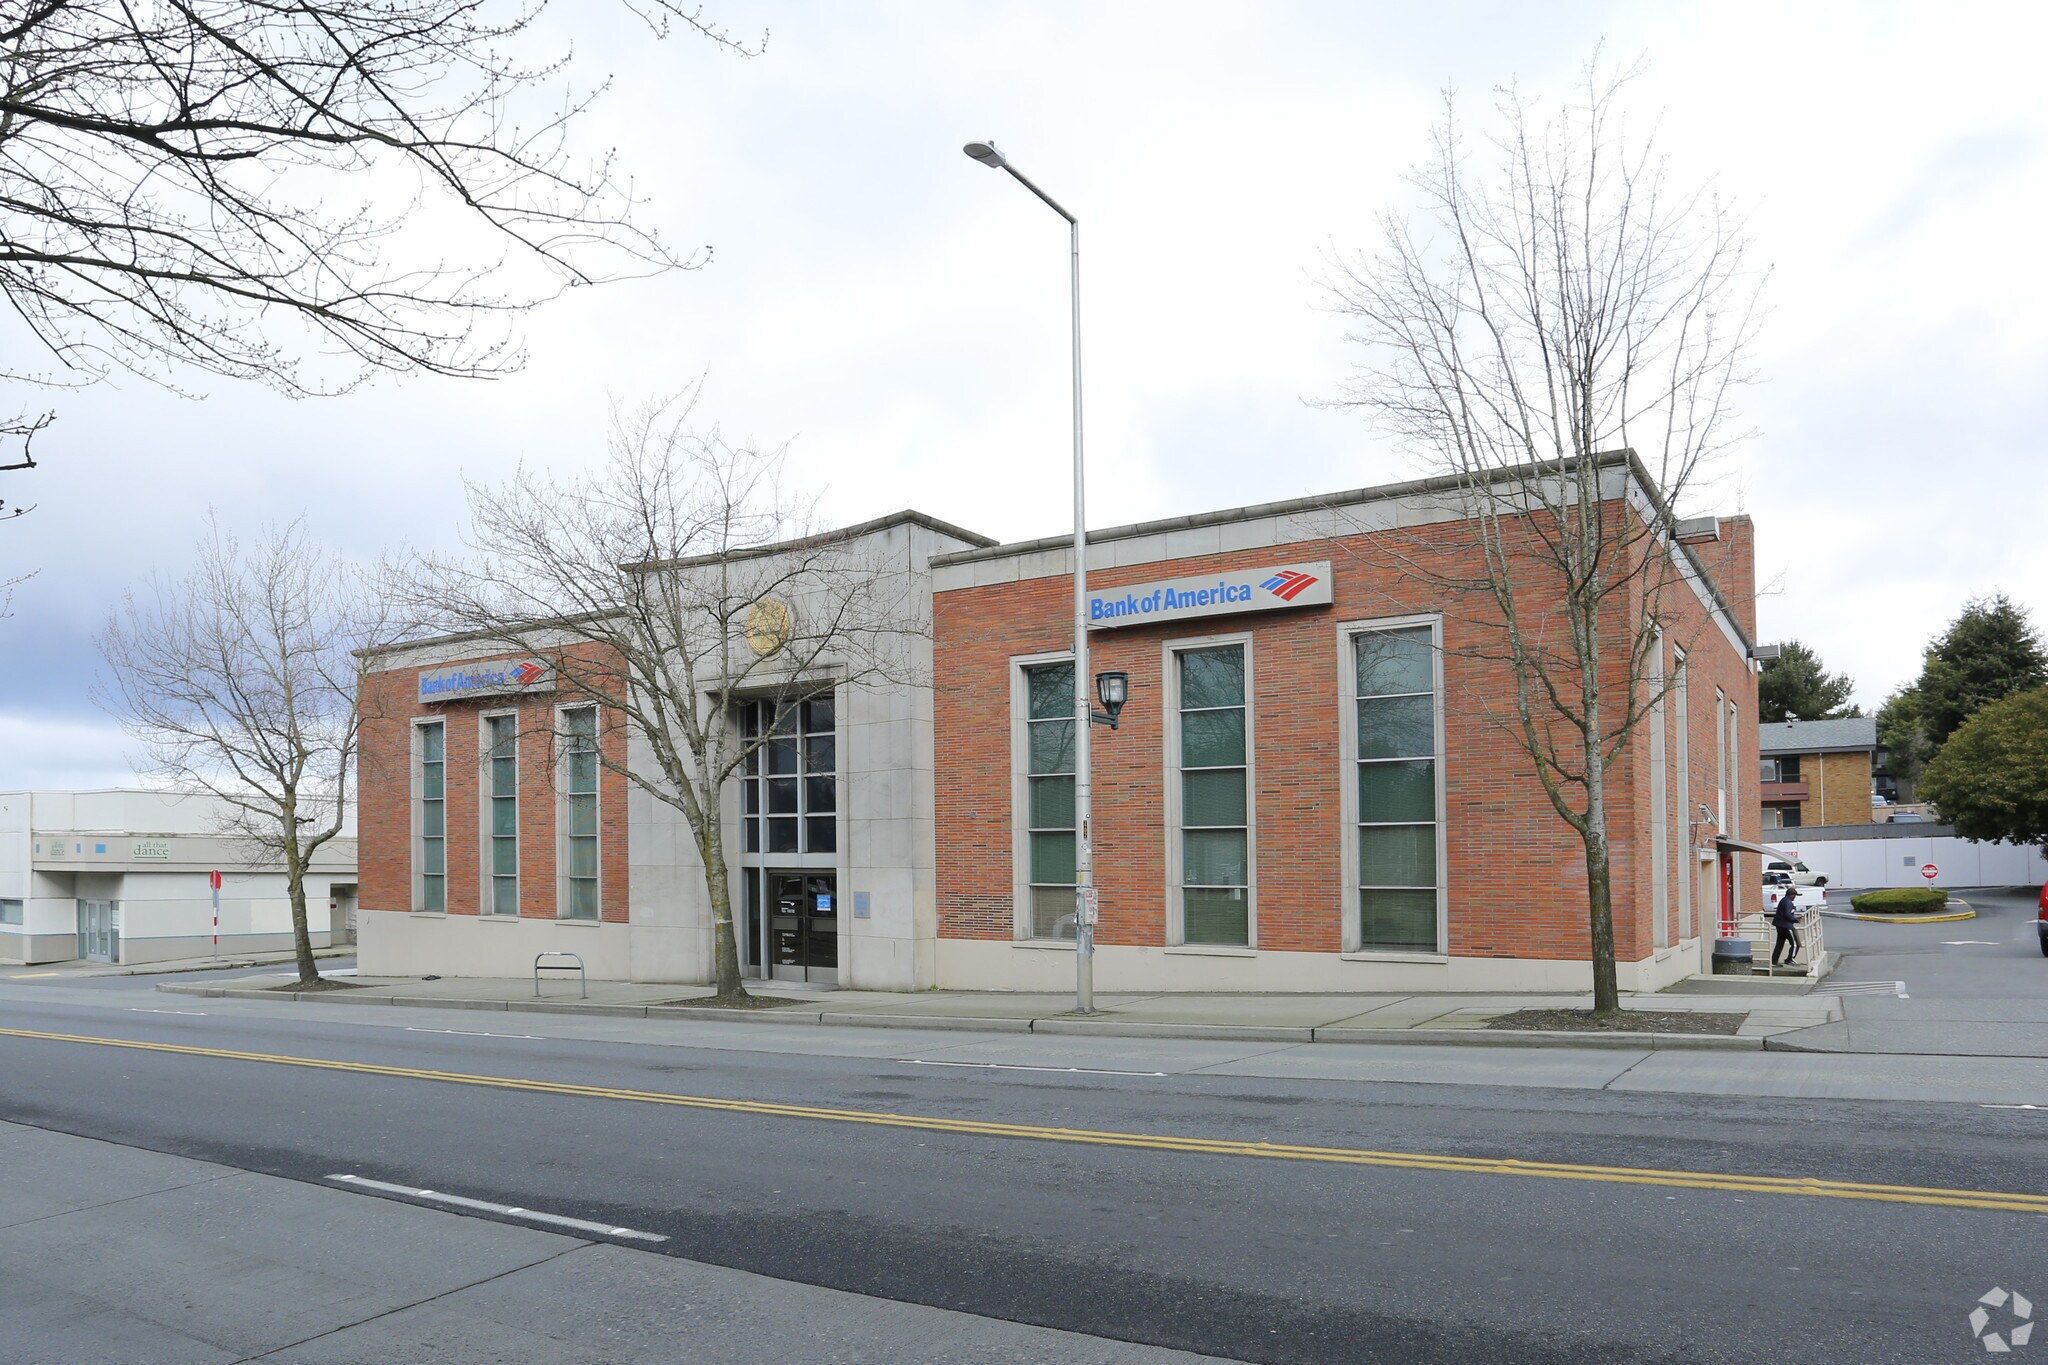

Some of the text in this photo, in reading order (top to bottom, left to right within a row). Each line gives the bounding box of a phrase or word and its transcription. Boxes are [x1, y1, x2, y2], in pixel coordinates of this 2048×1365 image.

[1090, 582, 1251, 620] Bank of America
[421, 675, 443, 694] Bank
[446, 672, 457, 690] of
[133, 844, 169, 856] dance
